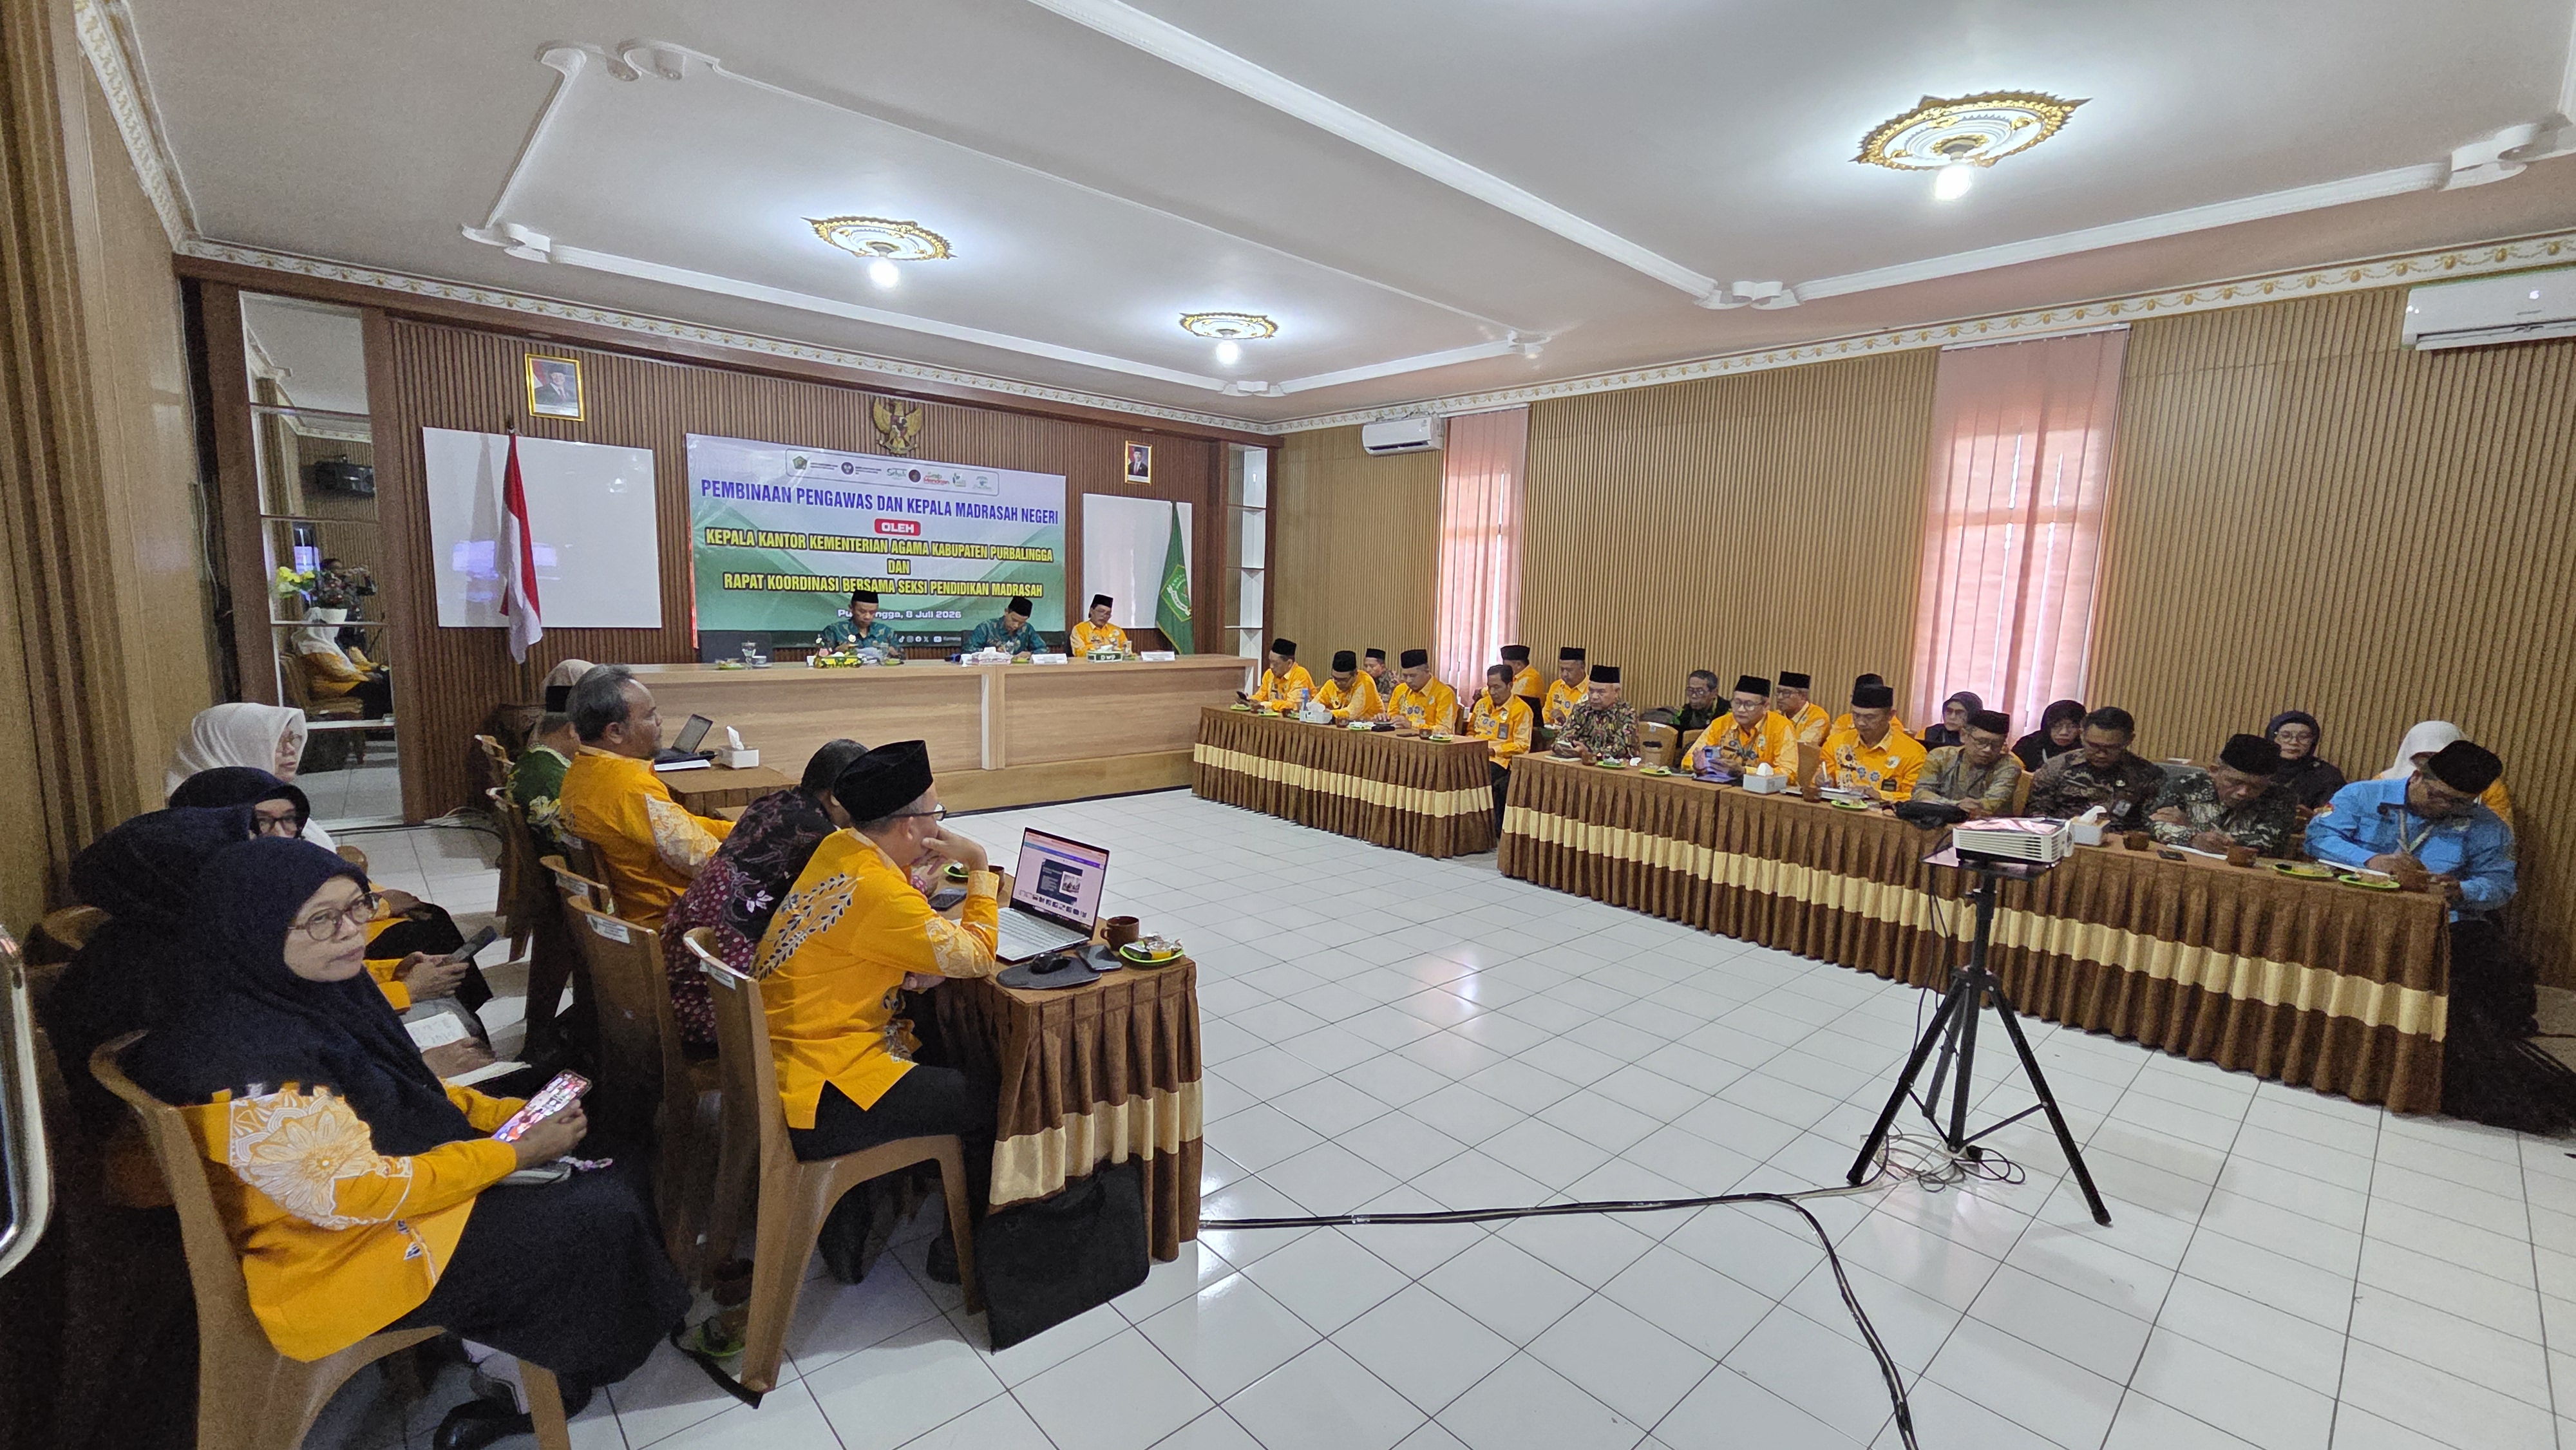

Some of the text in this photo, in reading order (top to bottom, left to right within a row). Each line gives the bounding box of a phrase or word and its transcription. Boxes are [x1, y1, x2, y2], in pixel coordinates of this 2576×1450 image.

[701, 479, 1059, 525] PEMBINAAN PENGAWAS DAN KEPALA MADRASAH NEGERI
[881, 522, 914, 533] OLEH
[706, 529, 1053, 561] KEPALA KANTOR KEMENTERIAN AGAMA KABUPATEN PURBALINGGA
[888, 560, 910, 574] DAN
[724, 573, 1043, 597] RAPAT KOORDINASI BERSAMA SEKSI PENDIDIKAN MADRASAH
[838, 609, 904, 619] Pungga,
